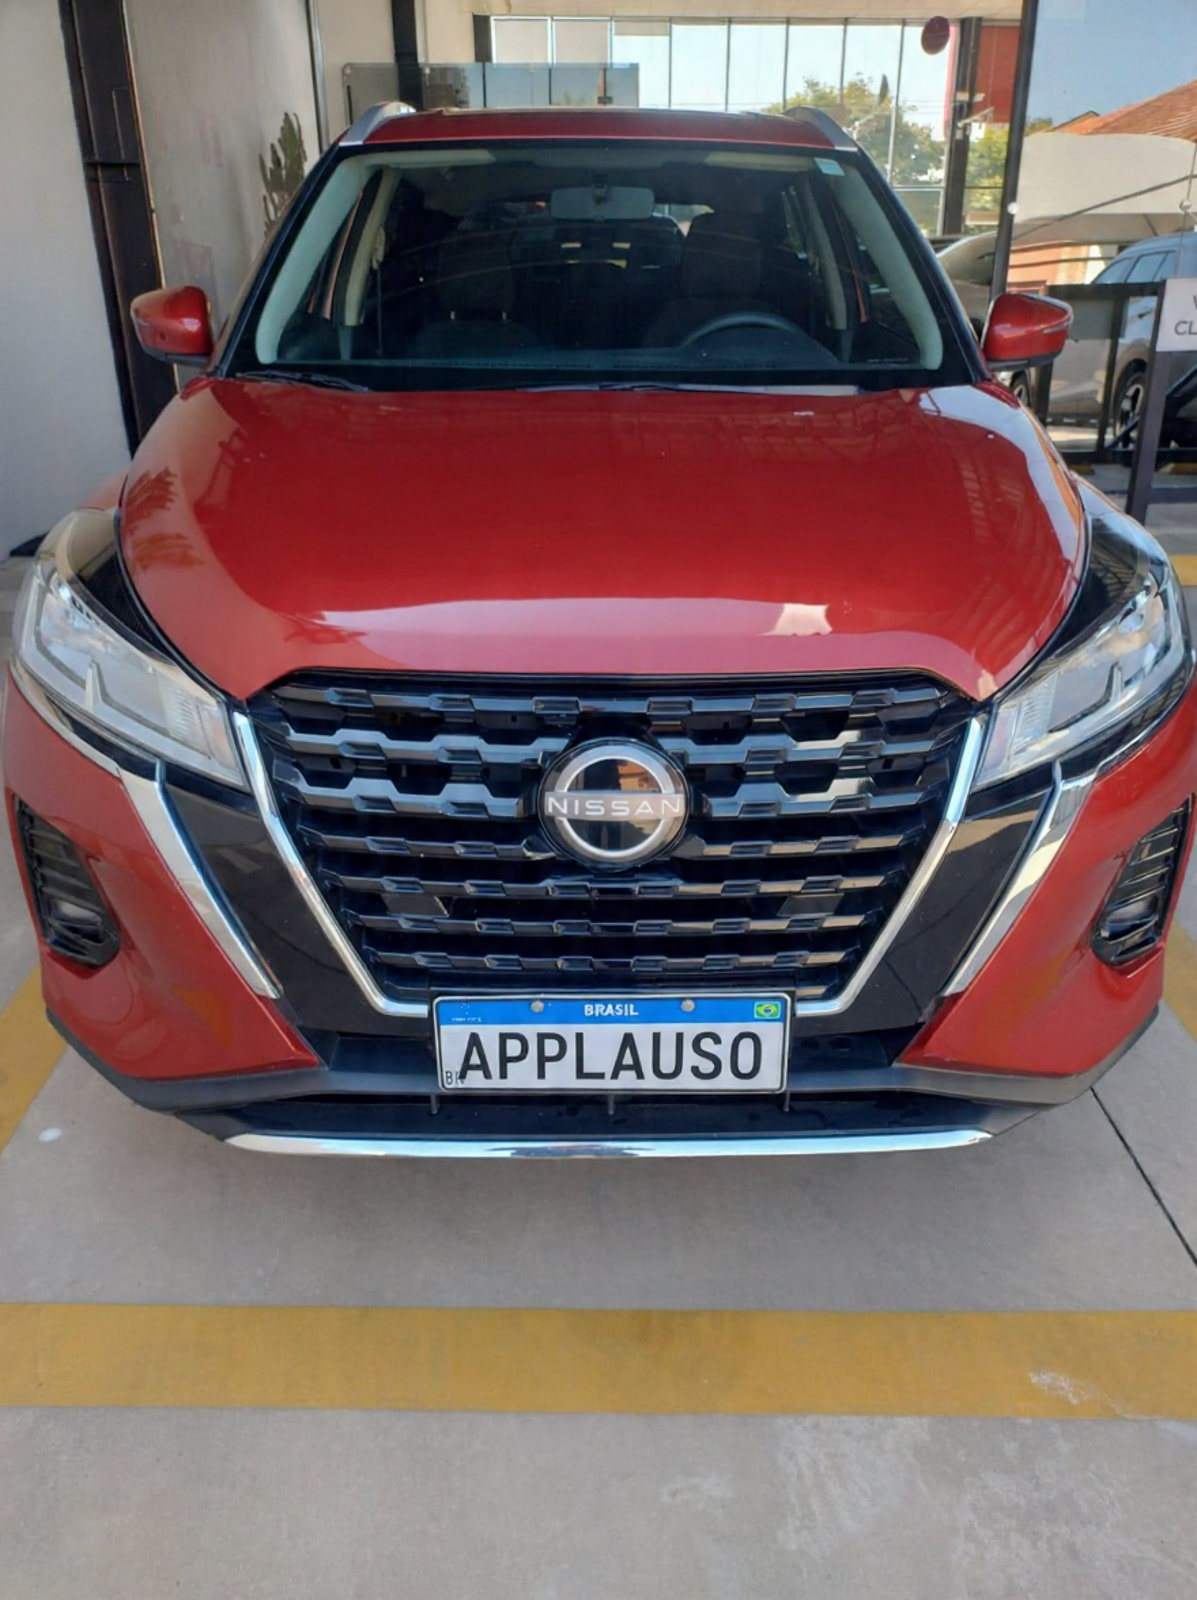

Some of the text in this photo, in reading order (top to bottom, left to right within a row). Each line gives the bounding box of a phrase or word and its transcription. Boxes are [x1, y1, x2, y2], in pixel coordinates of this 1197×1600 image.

[547, 796, 680, 816] NISSAN
[584, 1003, 639, 1017] BRASIL
[458, 1031, 763, 1080] APPLAUSO
